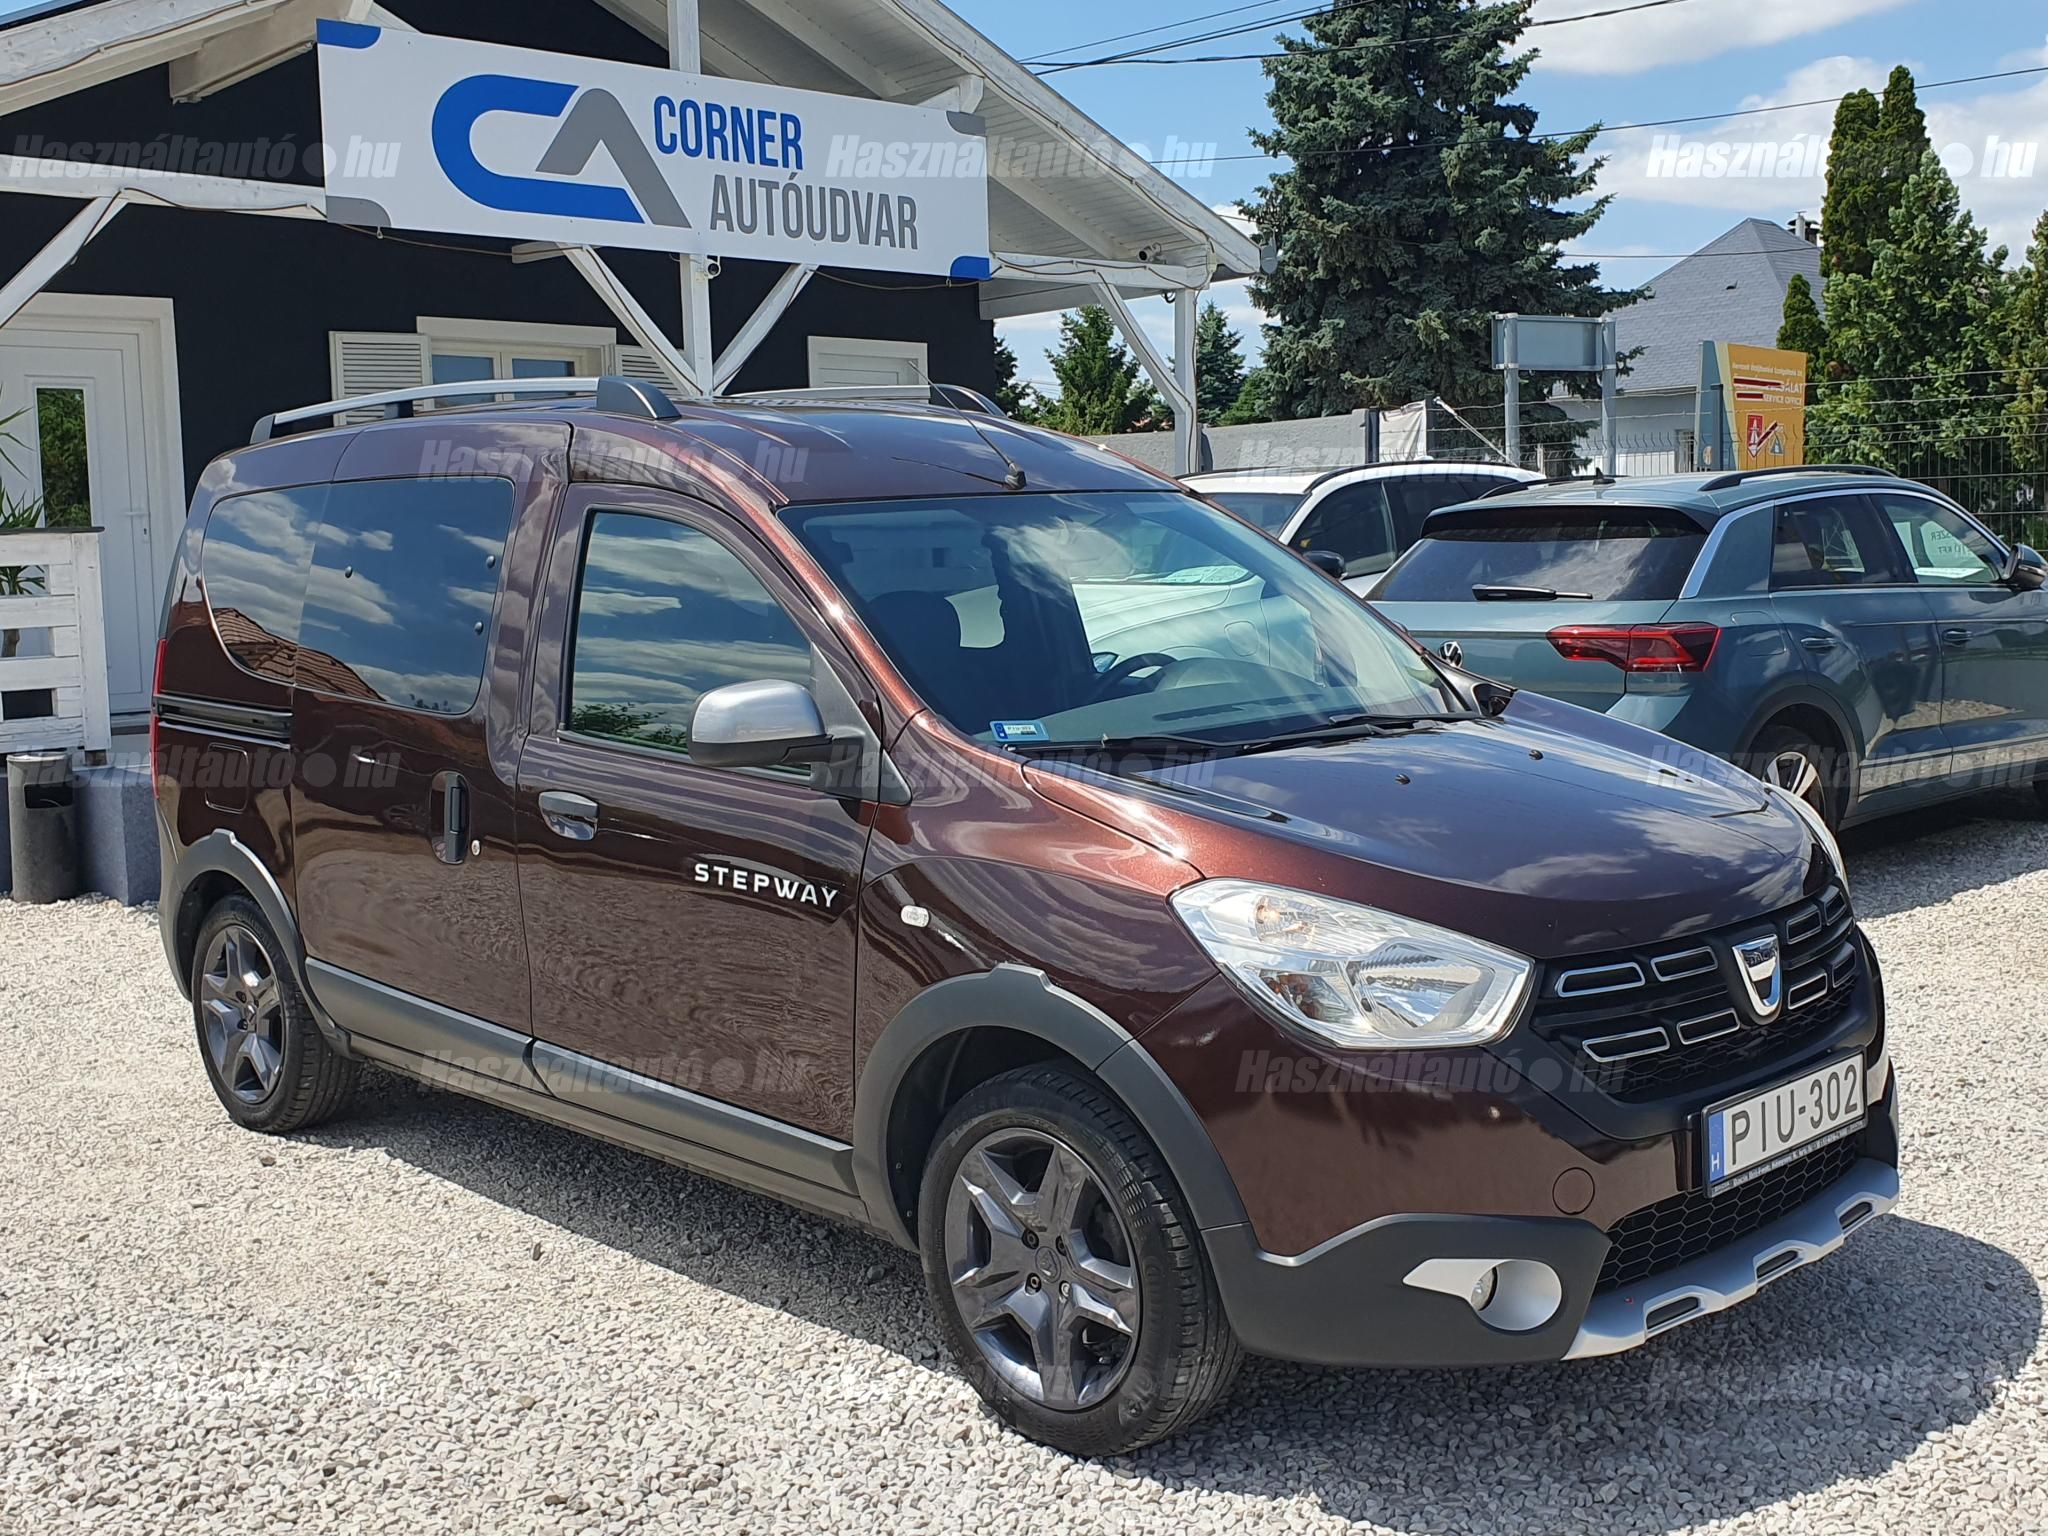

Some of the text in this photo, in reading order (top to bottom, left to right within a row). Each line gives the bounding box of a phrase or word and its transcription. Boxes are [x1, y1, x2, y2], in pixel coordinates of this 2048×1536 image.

[653, 95, 804, 171] CORNER
[710, 172, 918, 250] AUTÓUDVAR
[694, 863, 838, 908] STEPWAY
[1731, 1064, 1858, 1166] PIU-302
[1711, 1152, 1720, 1173] H
